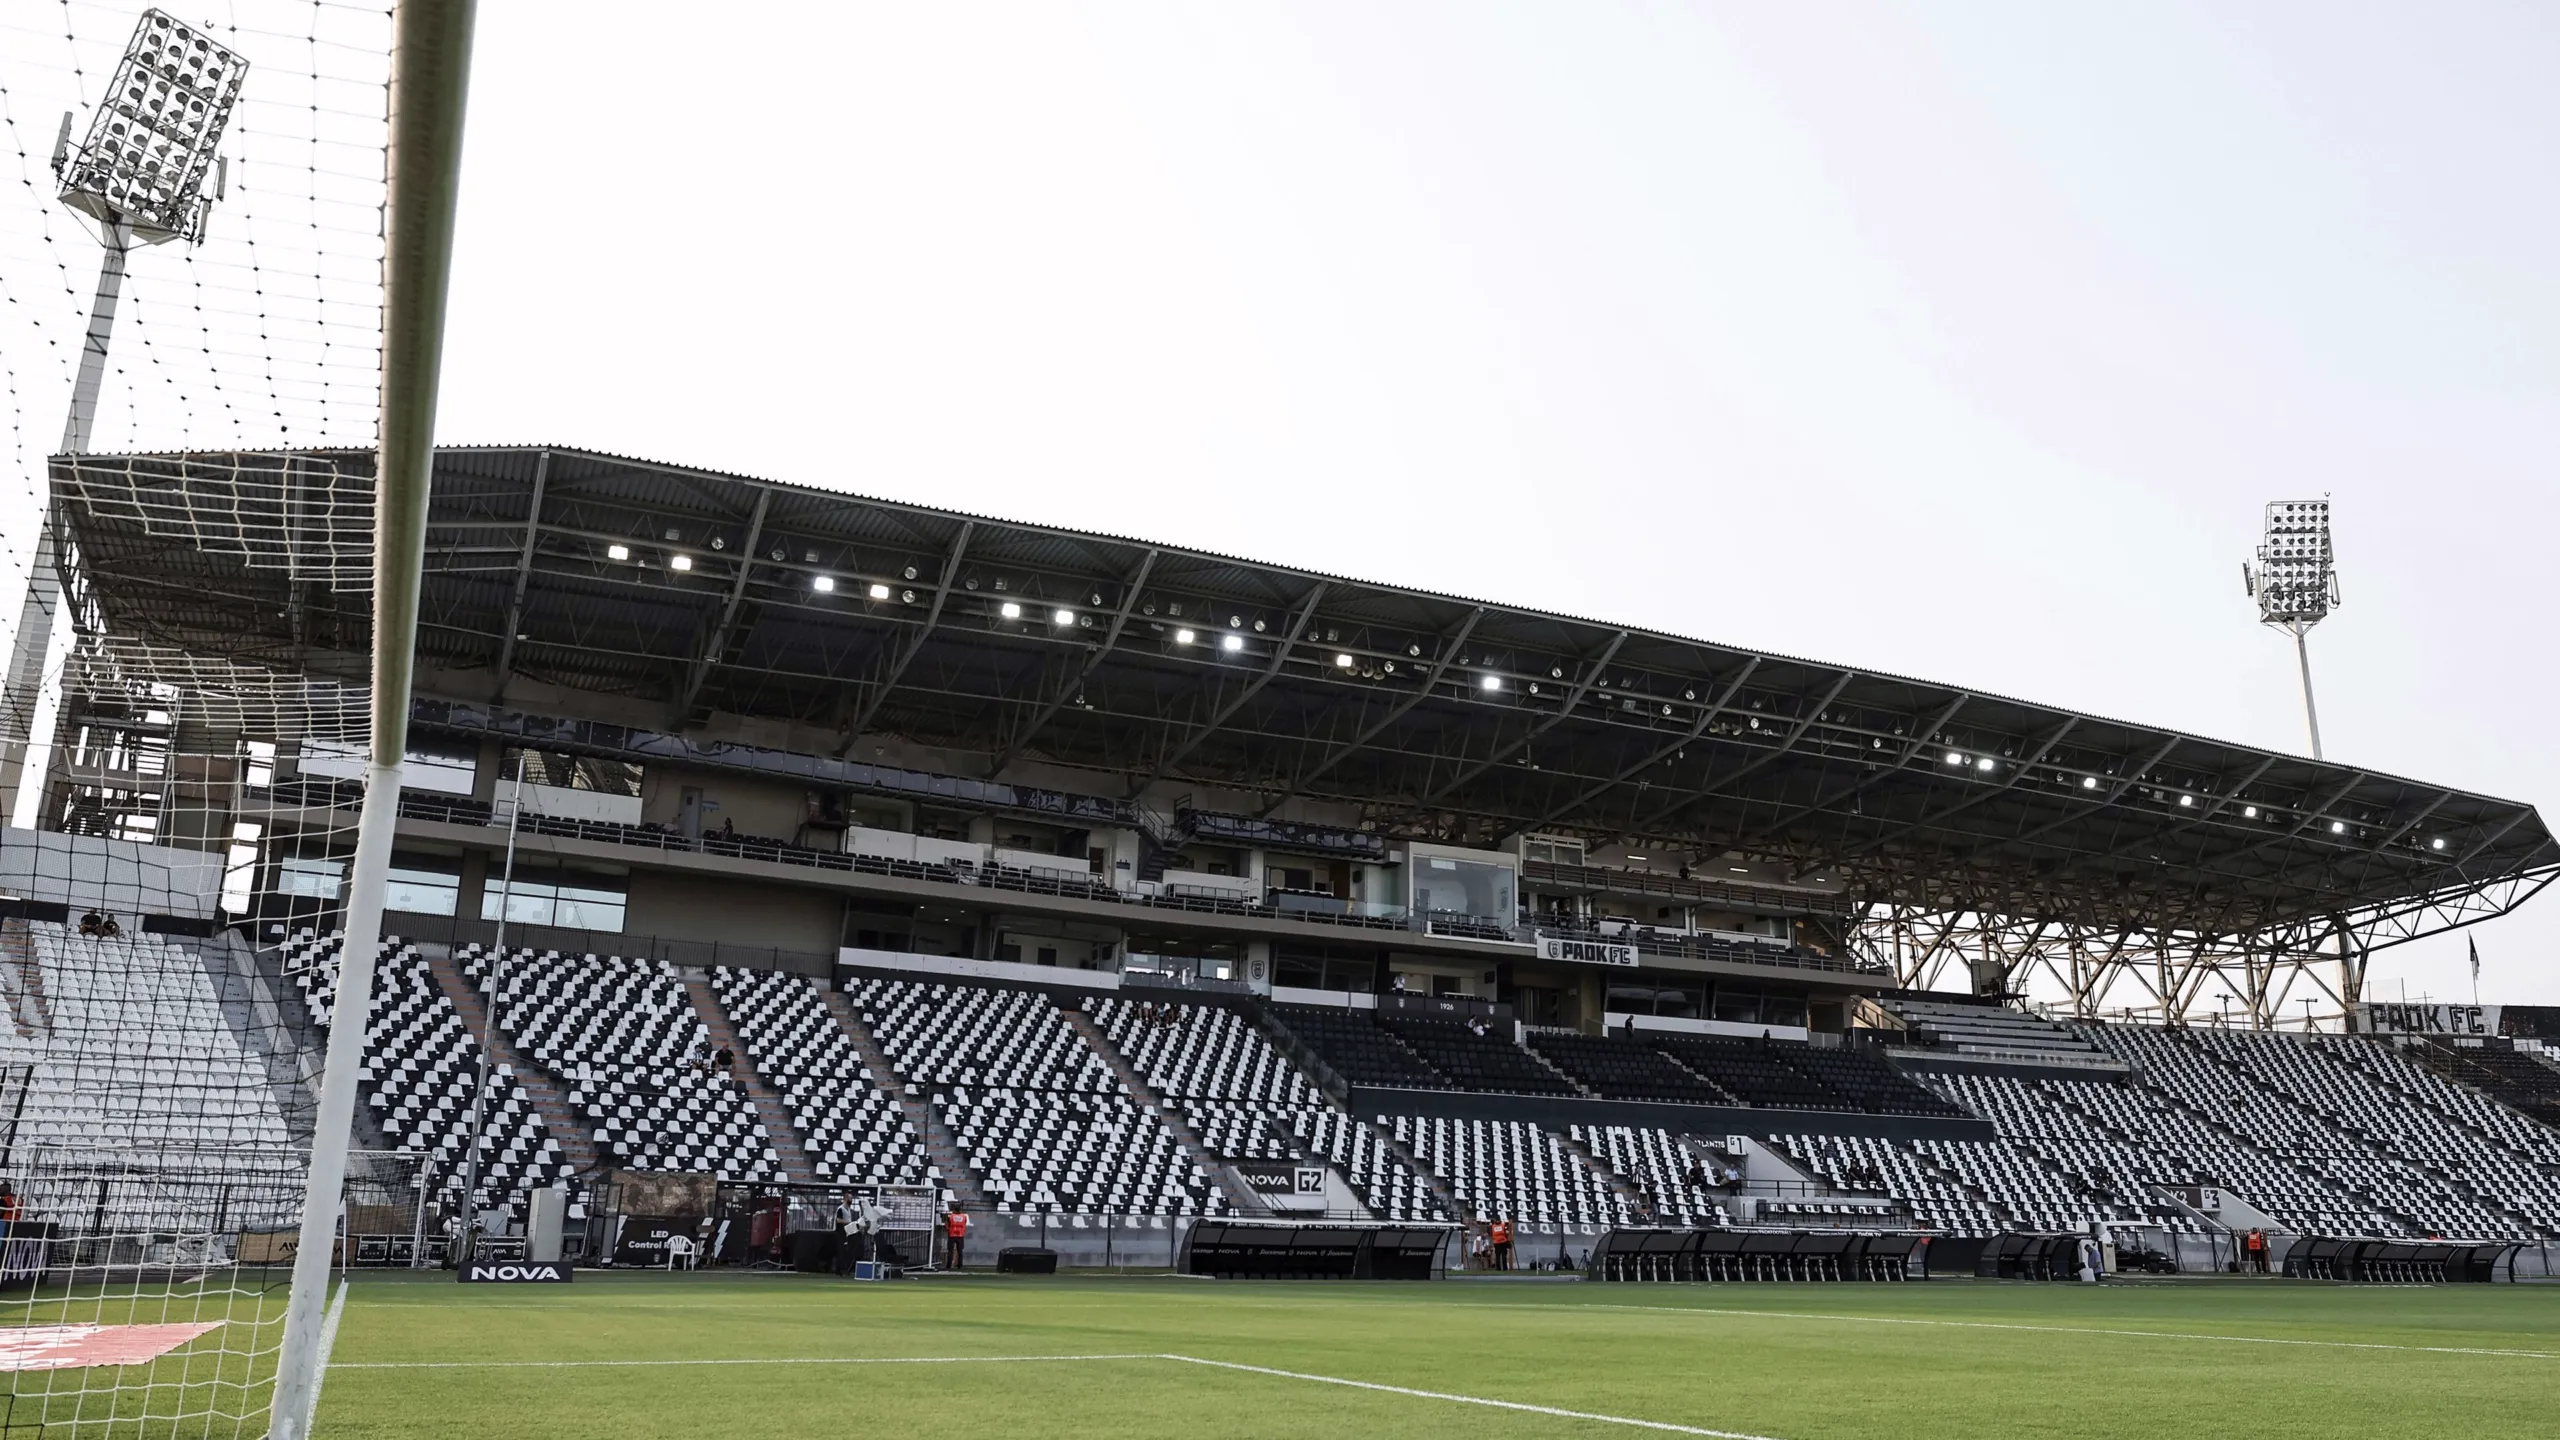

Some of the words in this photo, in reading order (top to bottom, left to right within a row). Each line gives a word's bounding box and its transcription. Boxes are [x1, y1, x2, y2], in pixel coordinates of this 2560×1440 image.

[1562, 942, 1608, 962] PAOK
[1610, 947, 1631, 964] FC
[1440, 1003, 1454, 1011] 1926
[2370, 1004, 2445, 1033] PAOK
[2448, 1006, 2485, 1033] FC
[1242, 1174, 1289, 1186] NOVA
[1298, 1171, 1322, 1192] G2
[651, 1230, 669, 1238] LED
[628, 1241, 662, 1249] Control
[470, 1266, 560, 1281] NOVA
